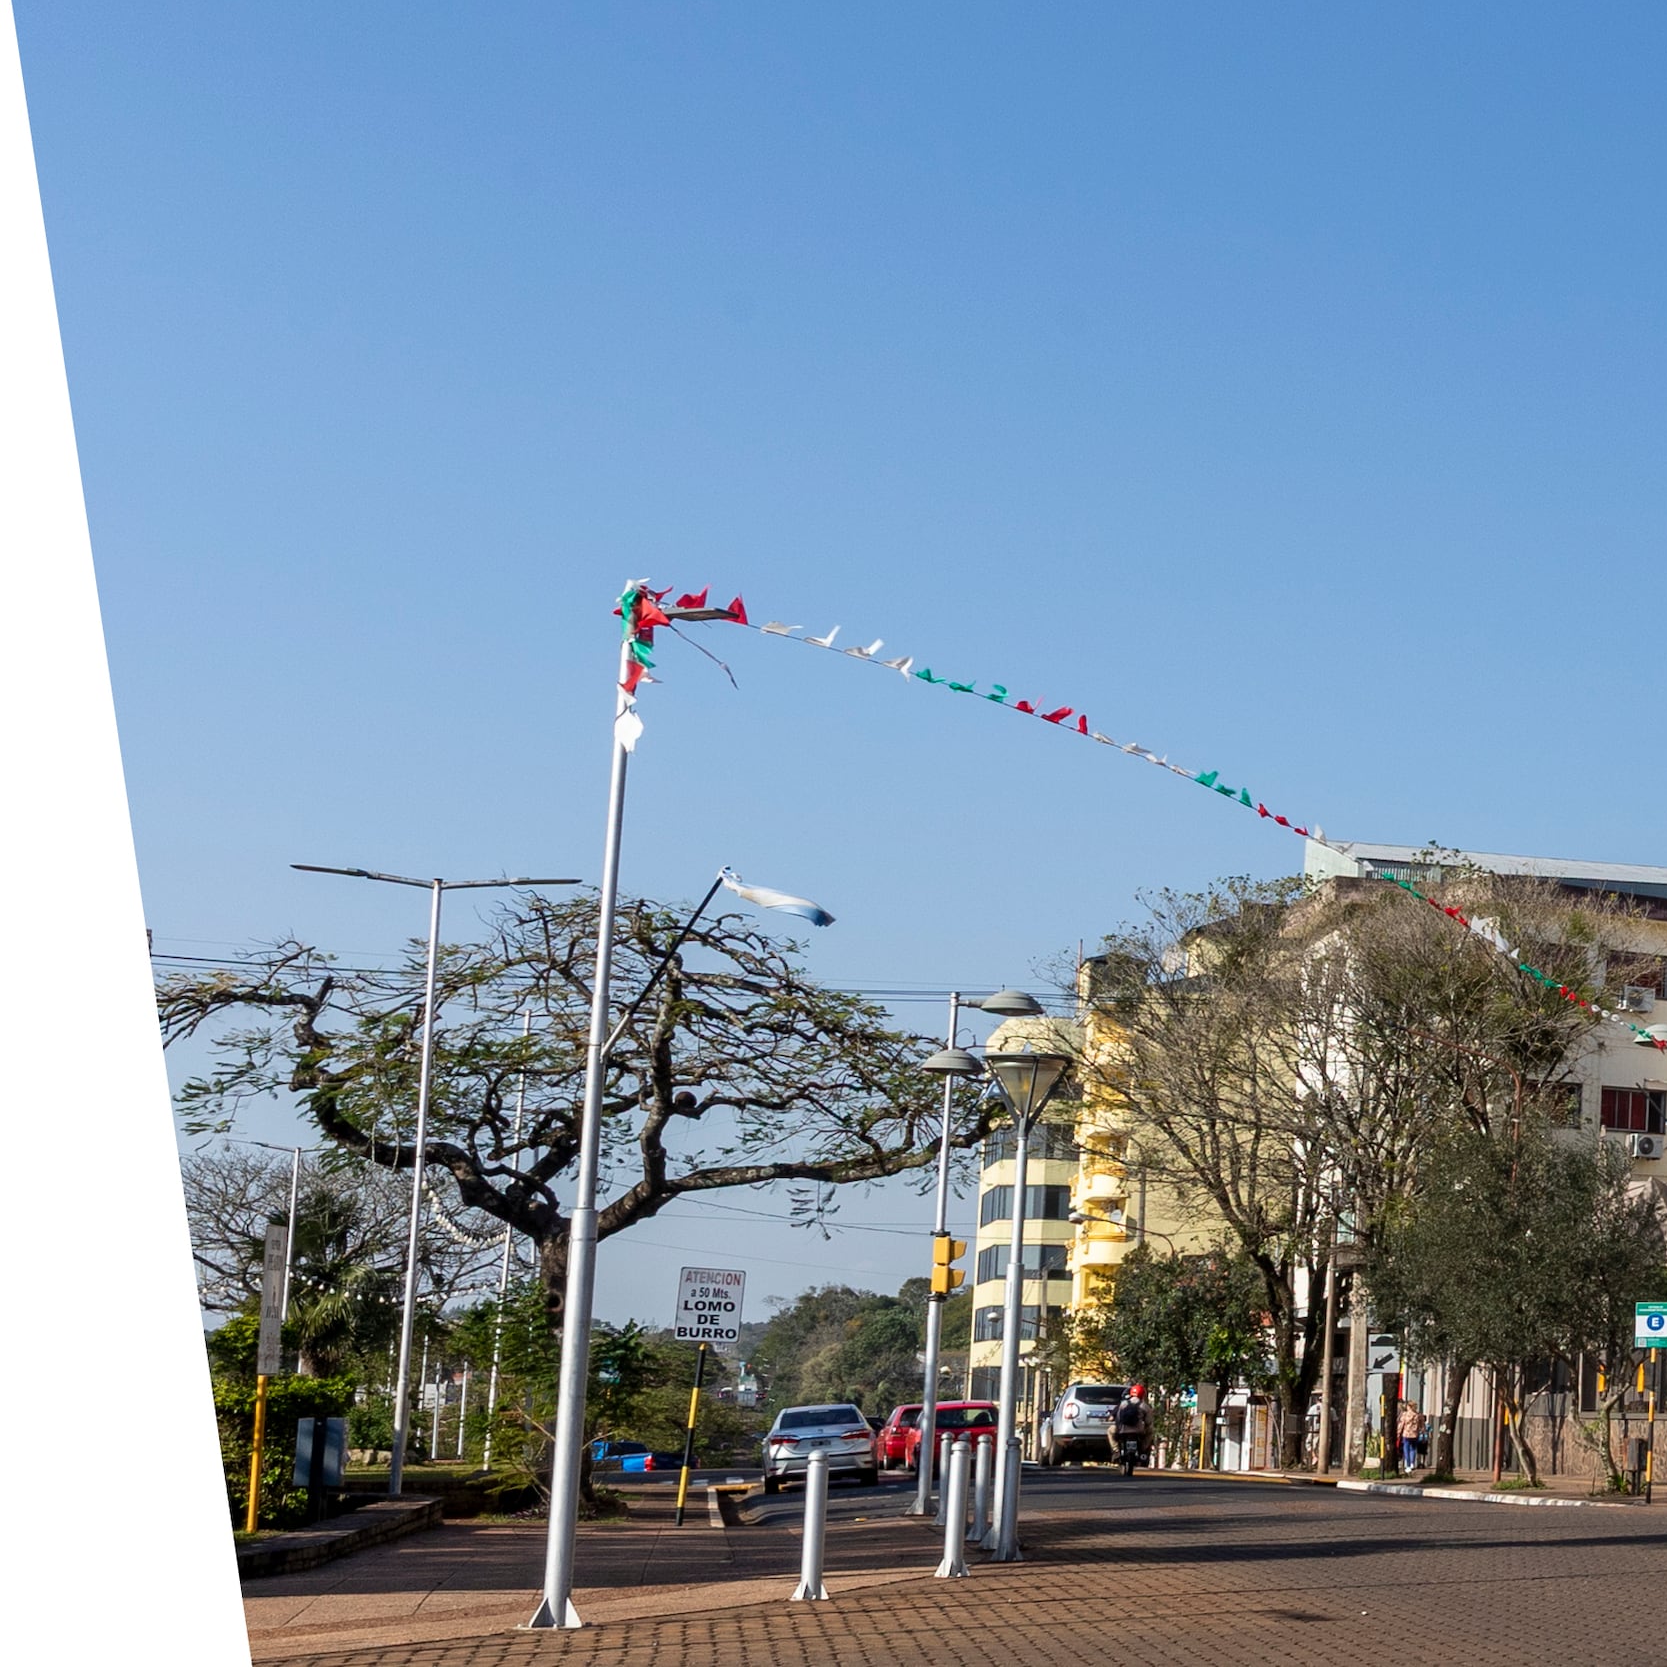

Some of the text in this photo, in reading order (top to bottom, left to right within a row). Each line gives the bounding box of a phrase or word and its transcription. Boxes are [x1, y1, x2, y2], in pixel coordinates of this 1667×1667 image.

[685, 1270, 742, 1286] ATENCION
[690, 1288, 697, 1297] a
[699, 1286, 710, 1298] 50
[683, 1300, 736, 1313] LOMO
[696, 1314, 720, 1326] DE
[1651, 1317, 1660, 1327] E
[676, 1326, 737, 1339] BURRO
